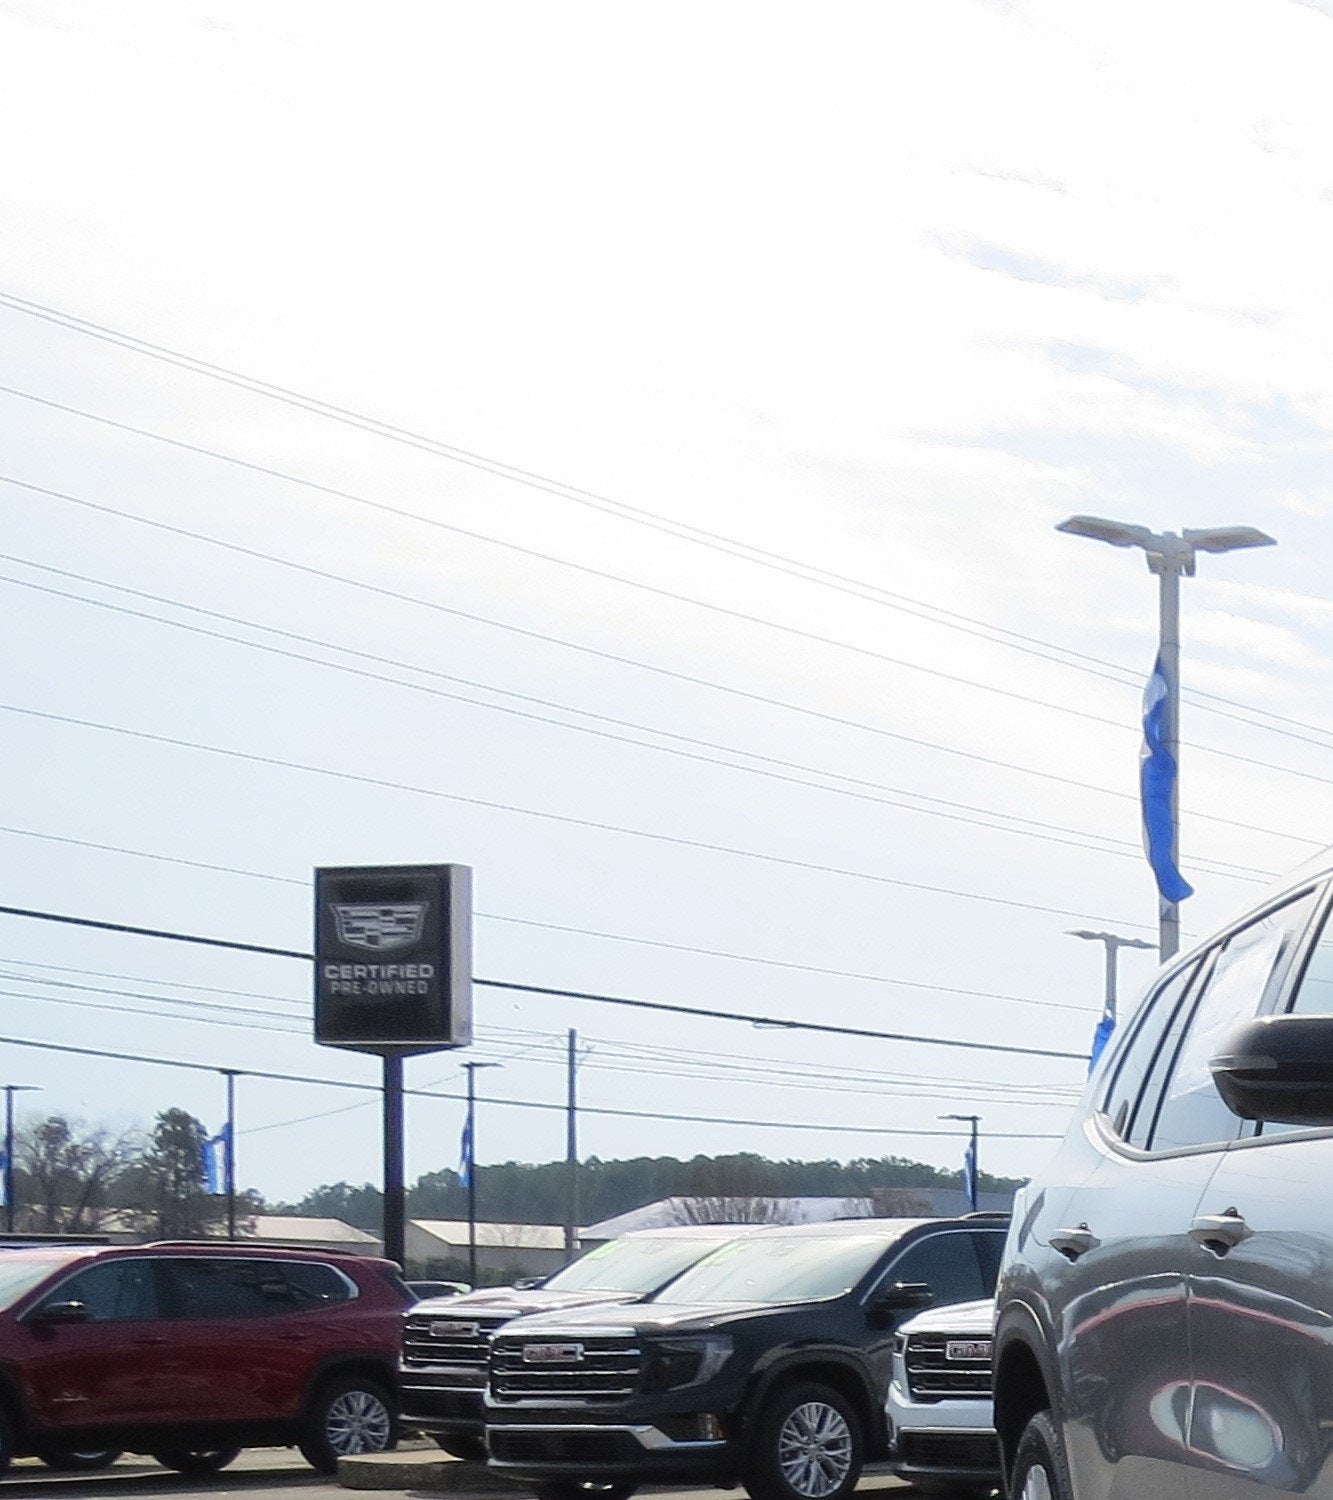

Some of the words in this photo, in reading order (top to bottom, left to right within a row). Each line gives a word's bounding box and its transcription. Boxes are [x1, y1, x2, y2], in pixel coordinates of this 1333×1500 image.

[324, 964, 435, 979] CERTIFIED
[330, 980, 429, 995] PRE-OWNED
[949, 1343, 992, 1358] GM
